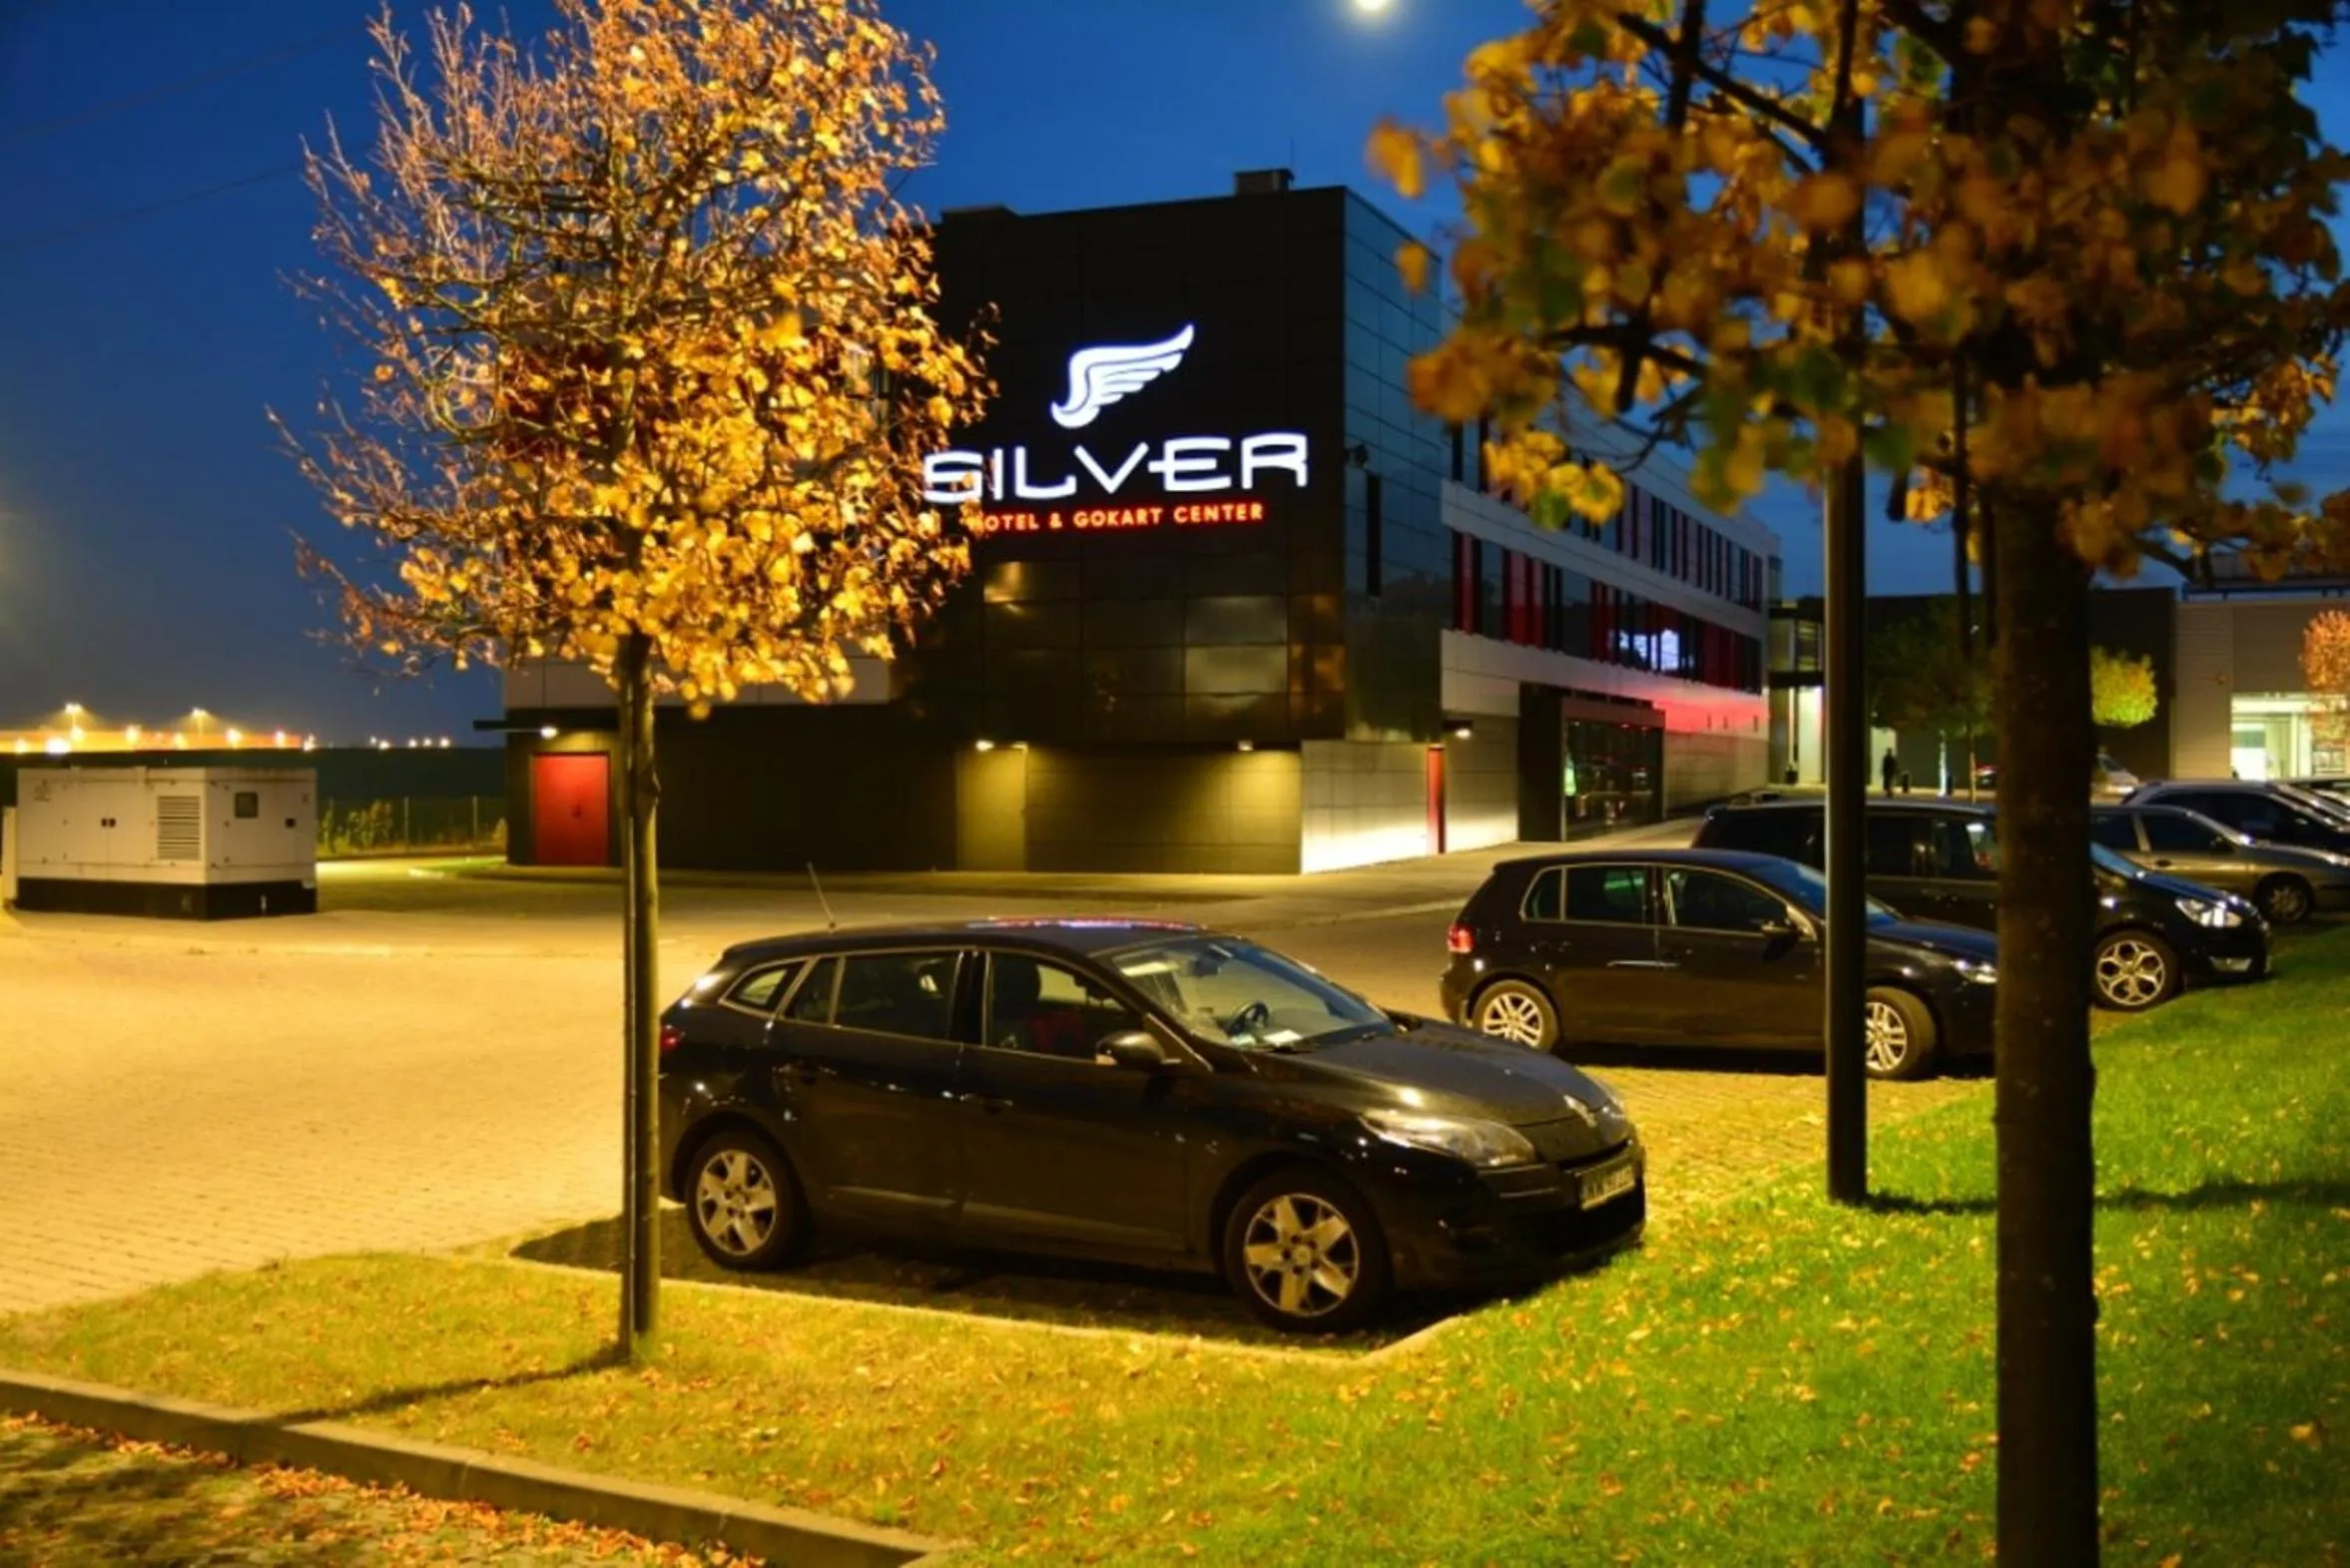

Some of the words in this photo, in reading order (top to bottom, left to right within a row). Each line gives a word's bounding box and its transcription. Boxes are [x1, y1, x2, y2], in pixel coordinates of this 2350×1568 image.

[923, 432, 1309, 503] SILVER
[972, 512, 1040, 532] OTEL
[1048, 511, 1063, 530] &
[1072, 506, 1163, 529] GOKART
[1172, 501, 1264, 525] CENTER
